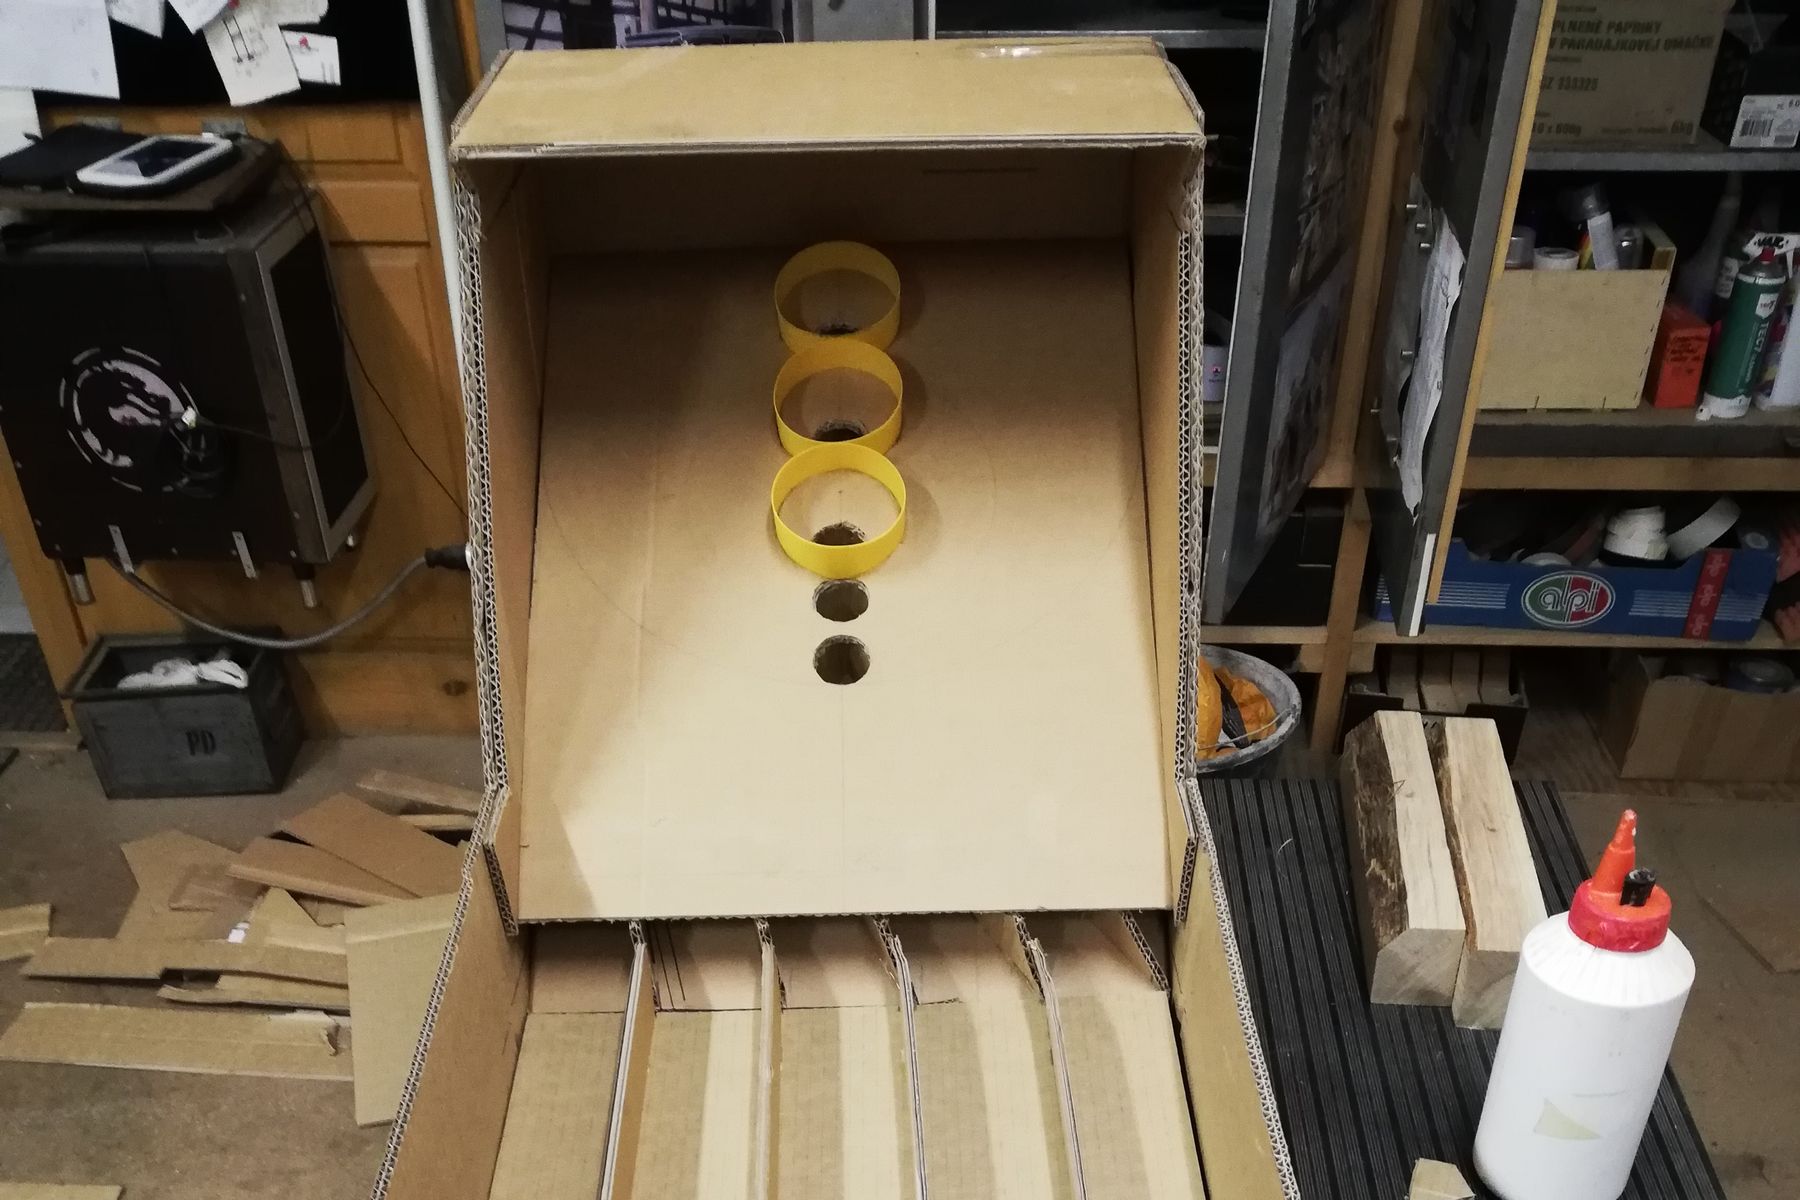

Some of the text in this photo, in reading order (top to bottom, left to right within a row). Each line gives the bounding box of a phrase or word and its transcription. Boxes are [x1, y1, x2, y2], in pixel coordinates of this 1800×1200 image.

[1606, 20, 1662, 34] PAPRIKY
[1538, 575, 1600, 623] alpi
[185, 730, 217, 756] PD
